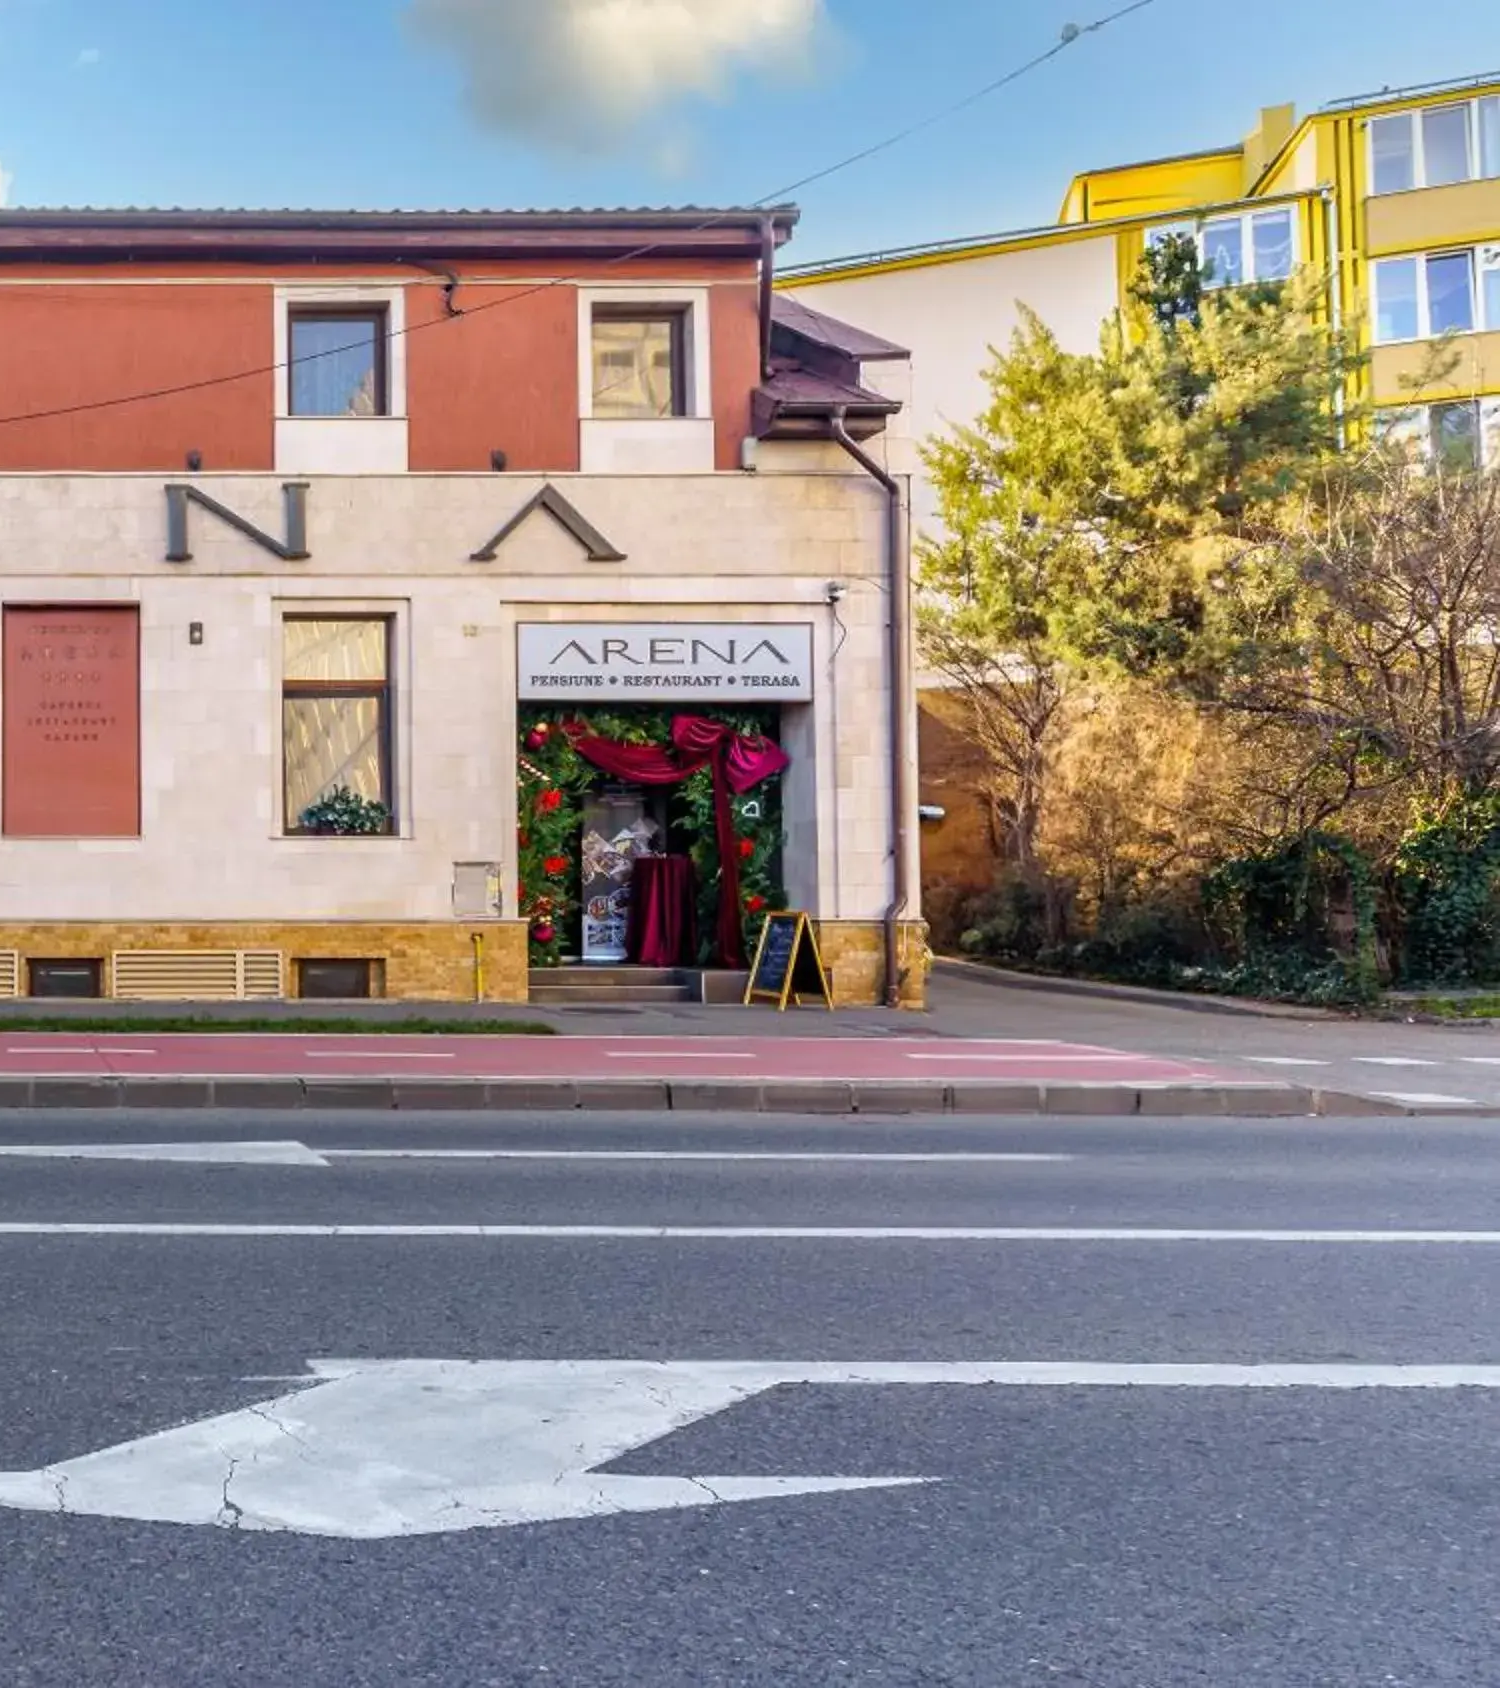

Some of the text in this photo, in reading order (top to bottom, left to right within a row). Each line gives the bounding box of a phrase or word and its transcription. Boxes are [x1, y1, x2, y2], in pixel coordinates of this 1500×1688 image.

[549, 639, 791, 665] ARENA
[531, 675, 800, 687] PENSIUNE RESTAURANT TERASA
